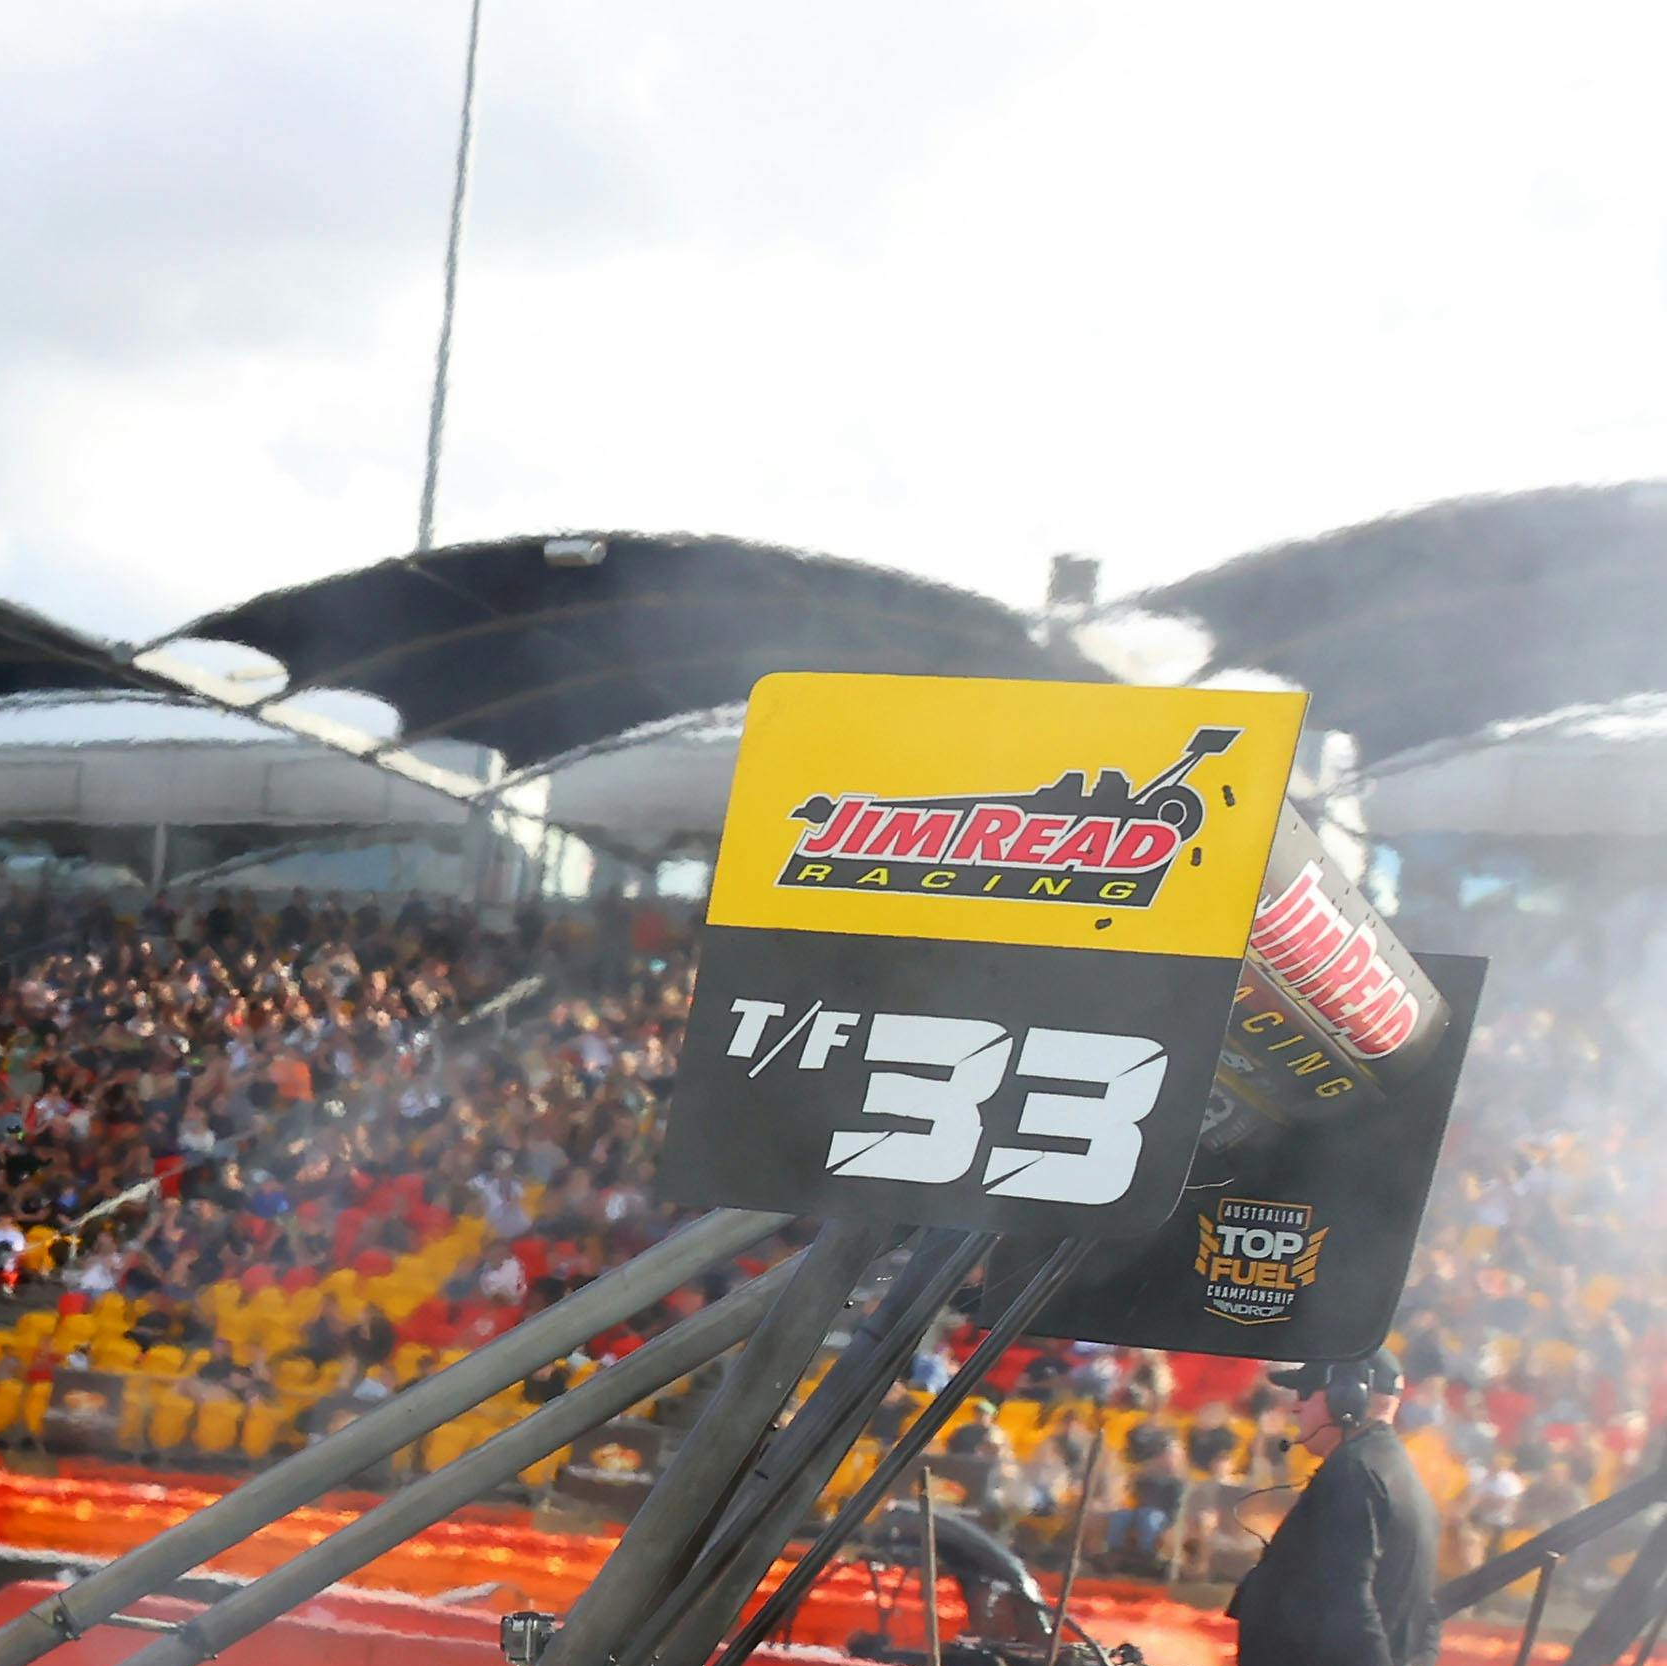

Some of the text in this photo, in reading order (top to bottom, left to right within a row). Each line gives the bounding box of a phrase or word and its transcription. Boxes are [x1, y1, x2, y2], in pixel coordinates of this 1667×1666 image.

[803, 799, 1179, 869] JIM READ
[796, 863, 1138, 900] RACING
[1305, 925, 1418, 1054] READ
[727, 998, 860, 1079] T/F
[825, 1013, 1169, 1206] 33
[1224, 1204, 1306, 1225] AUSTRALIAN
[1217, 1224, 1304, 1261] TOP
[1209, 1256, 1297, 1290] FUEL
[1206, 1284, 1296, 1305] CHAMPIONSHIP
